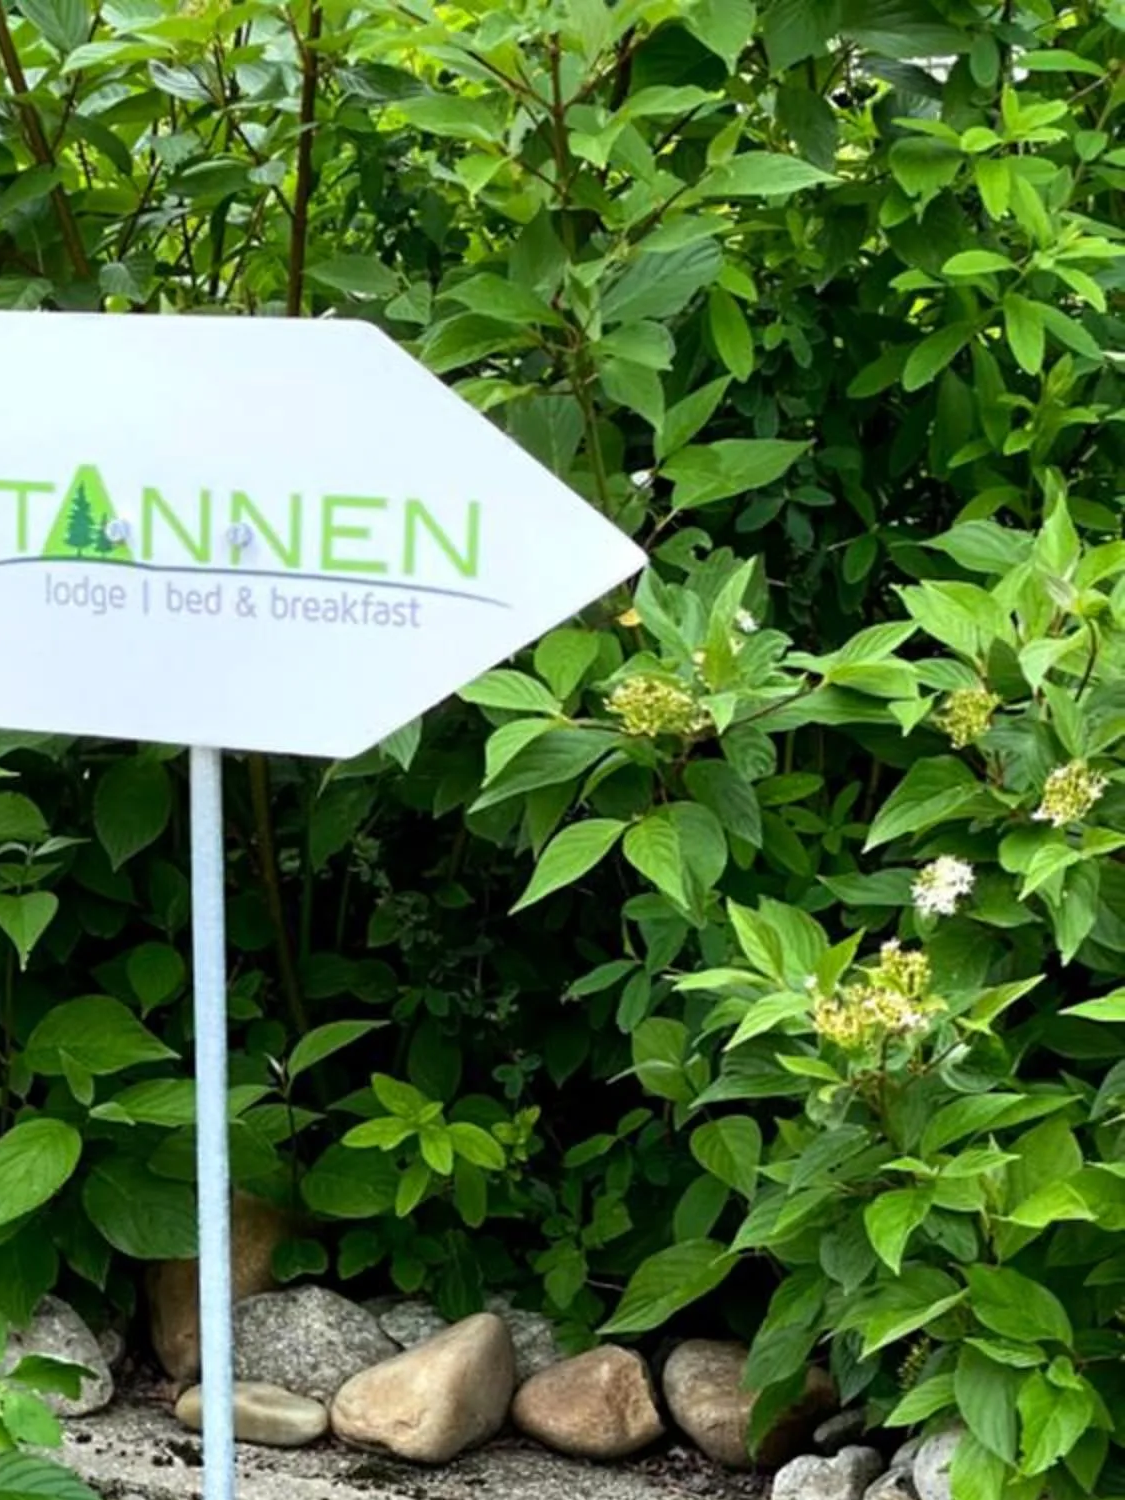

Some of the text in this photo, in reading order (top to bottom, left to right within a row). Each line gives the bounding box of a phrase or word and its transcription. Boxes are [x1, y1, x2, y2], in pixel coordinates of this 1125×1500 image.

[45, 573, 127, 615] lodge
[166, 583, 223, 616] bed
[234, 593, 259, 619] &
[270, 587, 422, 628] breakfast
